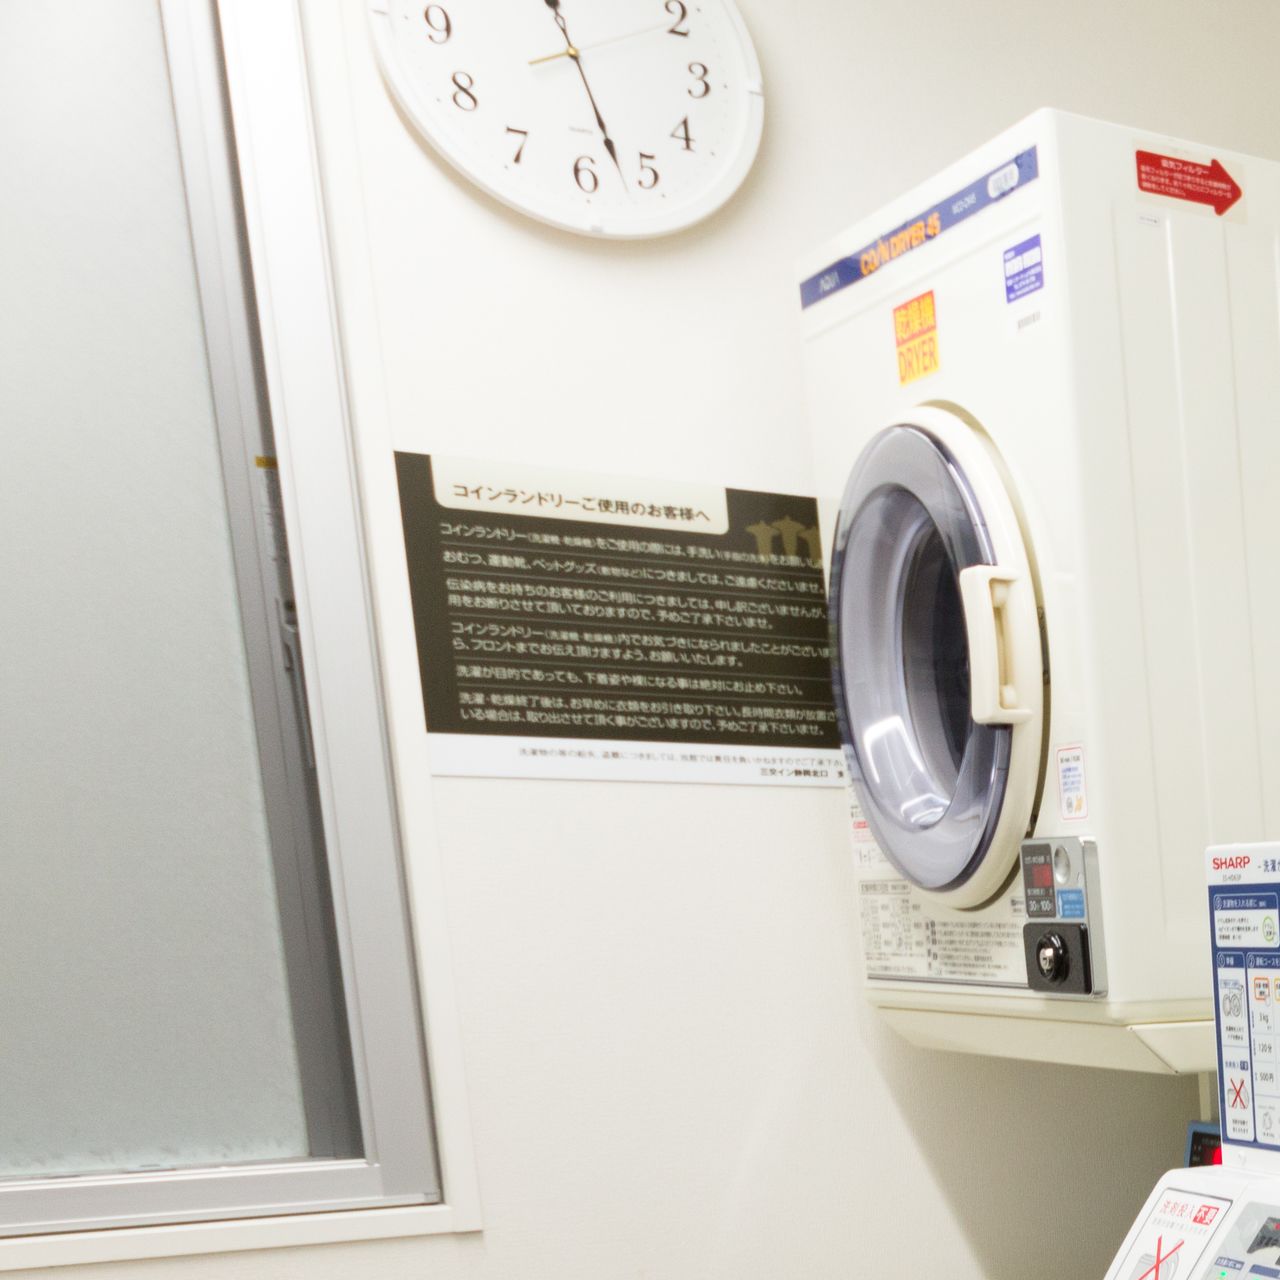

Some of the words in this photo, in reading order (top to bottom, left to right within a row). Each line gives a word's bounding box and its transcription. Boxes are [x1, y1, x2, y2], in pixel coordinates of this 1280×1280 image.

[424, 6, 451, 43] 9
[665, 0, 688, 37] 2
[451, 72, 478, 110] 8
[688, 64, 710, 97] 3
[506, 127, 528, 164] 7
[670, 116, 692, 152] 4
[572, 156, 599, 192] 6
[639, 152, 659, 187] 5
[891, 222, 926, 259] DRYER
[899, 338, 938, 381] DRYER
[454, 485, 709, 520] コインランドリーご使用のお客様へ
